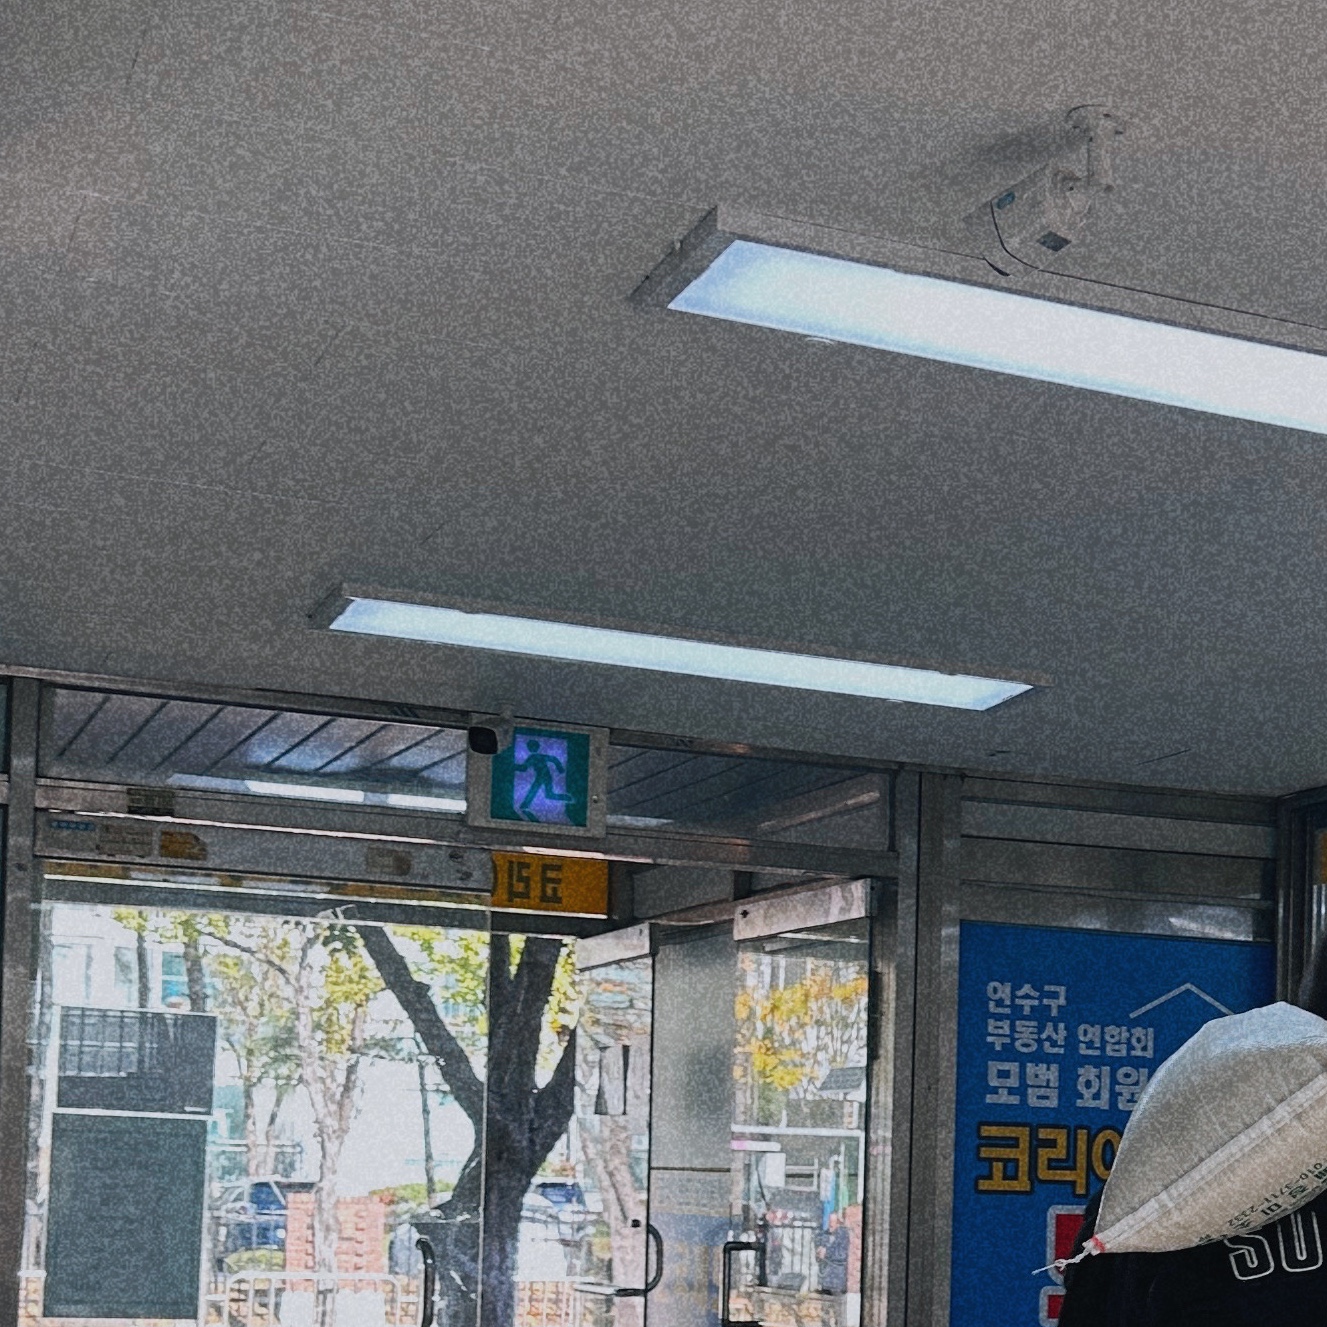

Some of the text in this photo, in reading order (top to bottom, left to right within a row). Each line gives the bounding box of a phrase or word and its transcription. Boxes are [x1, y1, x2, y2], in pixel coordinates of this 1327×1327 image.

[986, 981, 1067, 1017] 연수구
[986, 1018, 1154, 1058] 부동산 연합회
[986, 1060, 1149, 1111] 모범 회원
